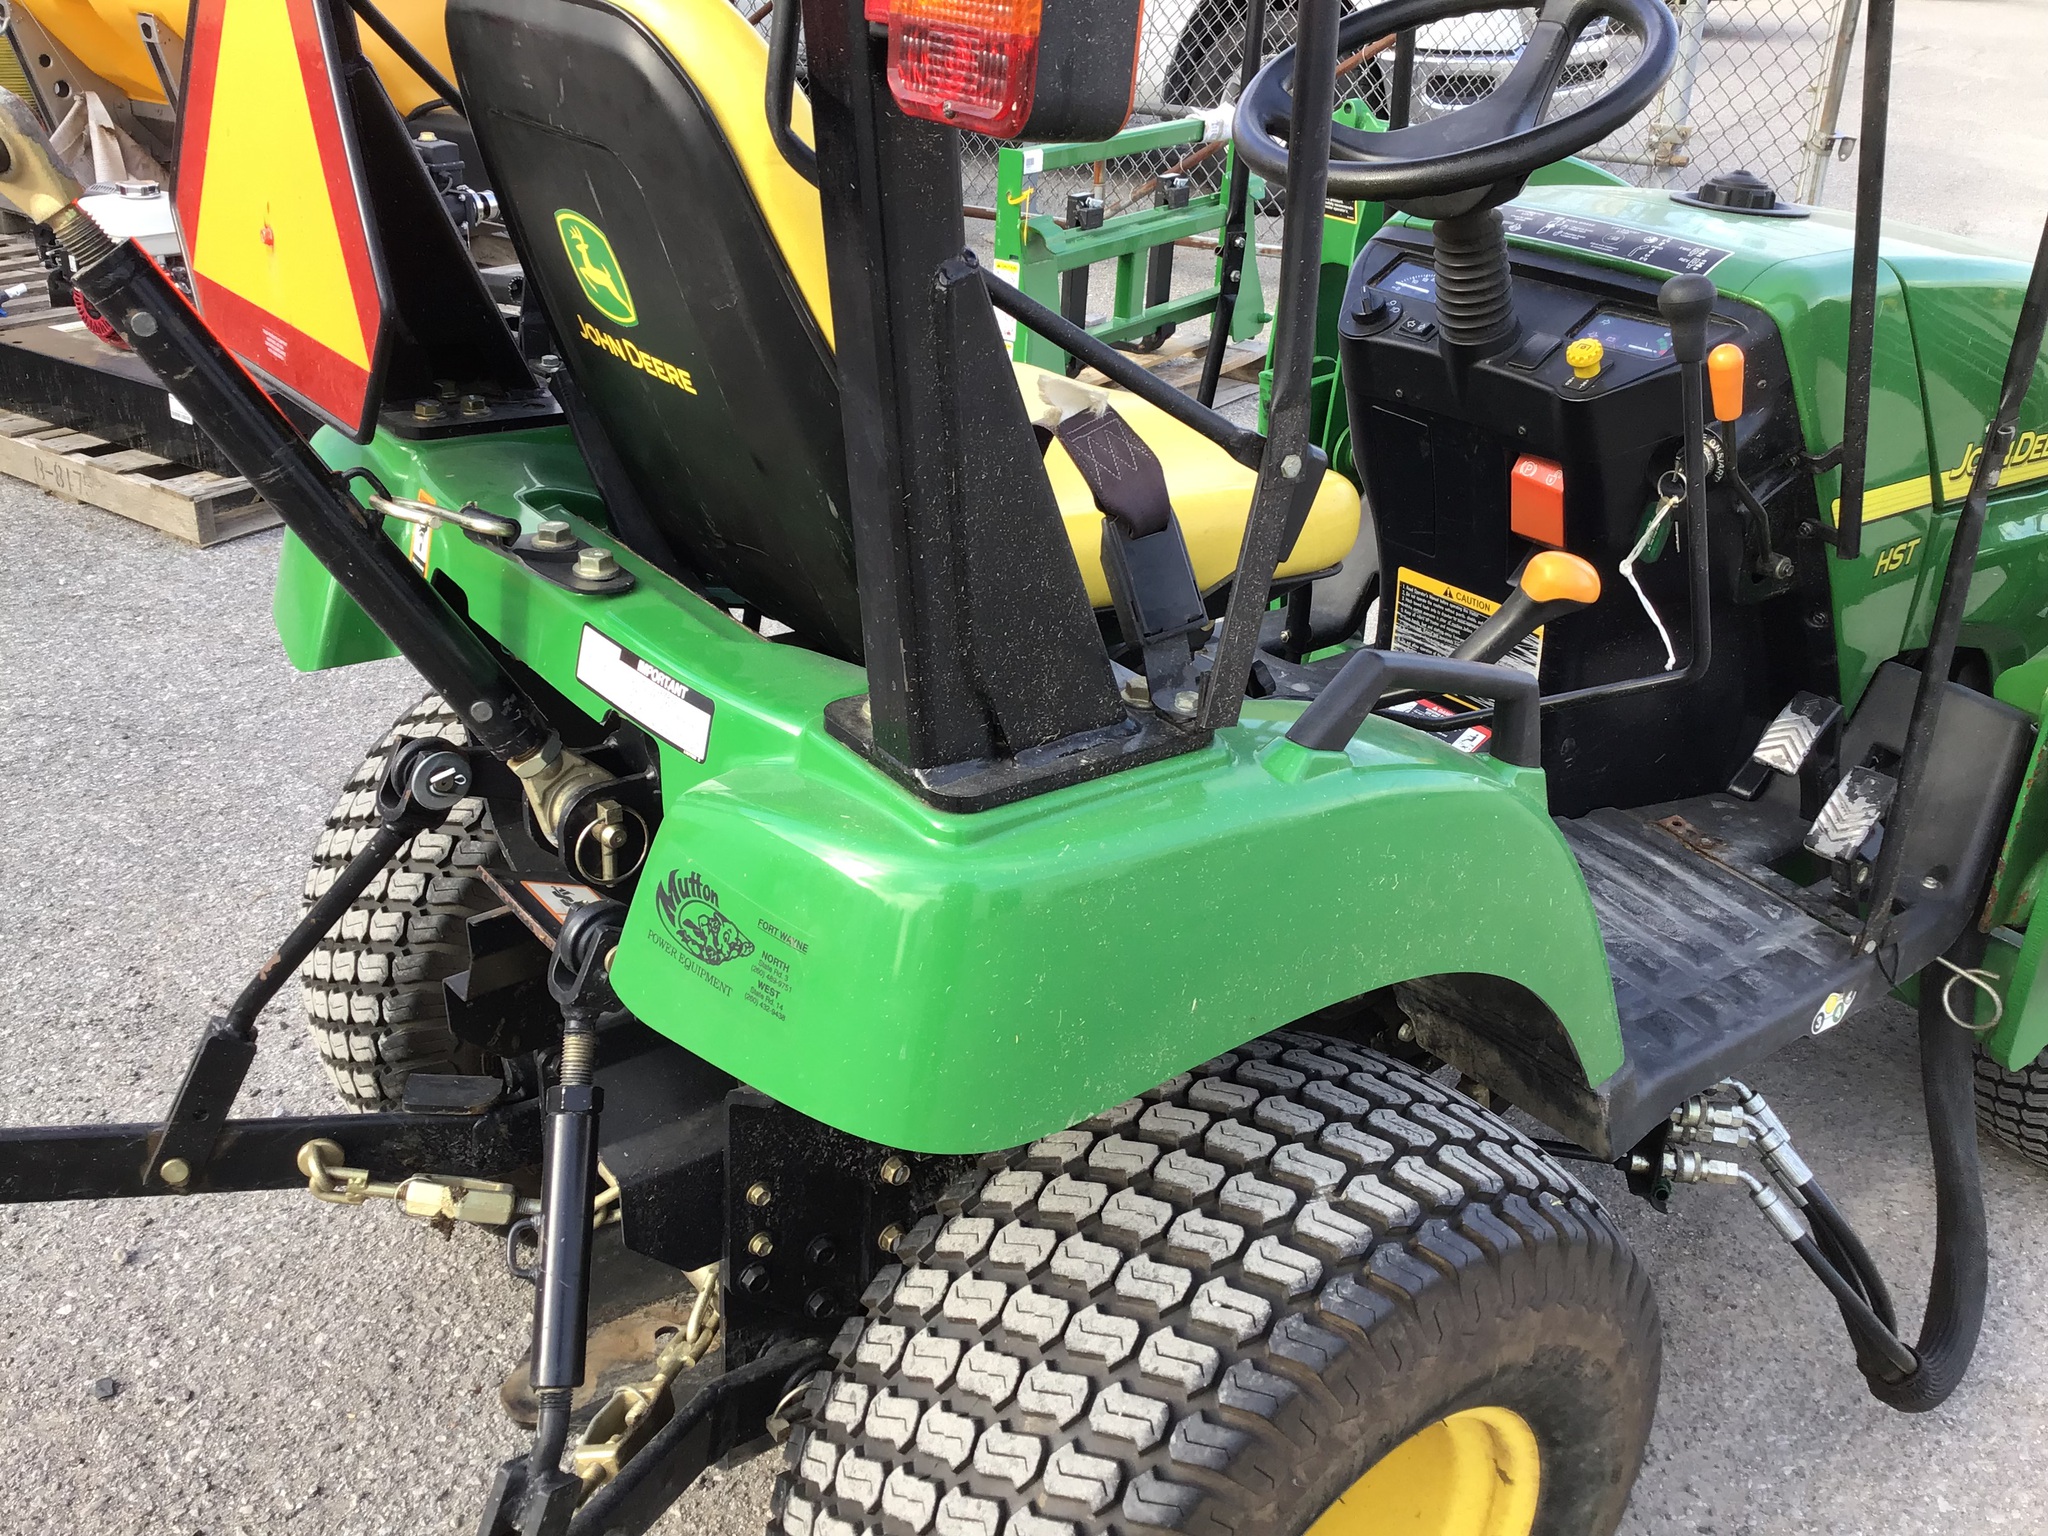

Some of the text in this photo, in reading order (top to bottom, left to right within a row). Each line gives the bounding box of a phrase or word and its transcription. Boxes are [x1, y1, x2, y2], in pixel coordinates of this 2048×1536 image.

[577, 314, 698, 395] JOHN DEERE
[1710, 438, 1722, 453] ON
[1714, 452, 1725, 482] START
[1873, 537, 1922, 577] HST
[1456, 592, 1491, 612] CAUTION
[636, 658, 690, 700] IMPORTANT
[655, 868, 720, 928] Mutton
[757, 918, 809, 954] FORT WAYNE
[647, 929, 734, 998] POWER EQUIPMENT
[758, 959, 772, 972] State
[774, 968, 783, 979] Rd.
[762, 950, 790, 973] NORTH
[750, 986, 784, 1011] State Rd. 14
[758, 980, 780, 999] WEST
[759, 1002, 786, 1022] 432-9438
